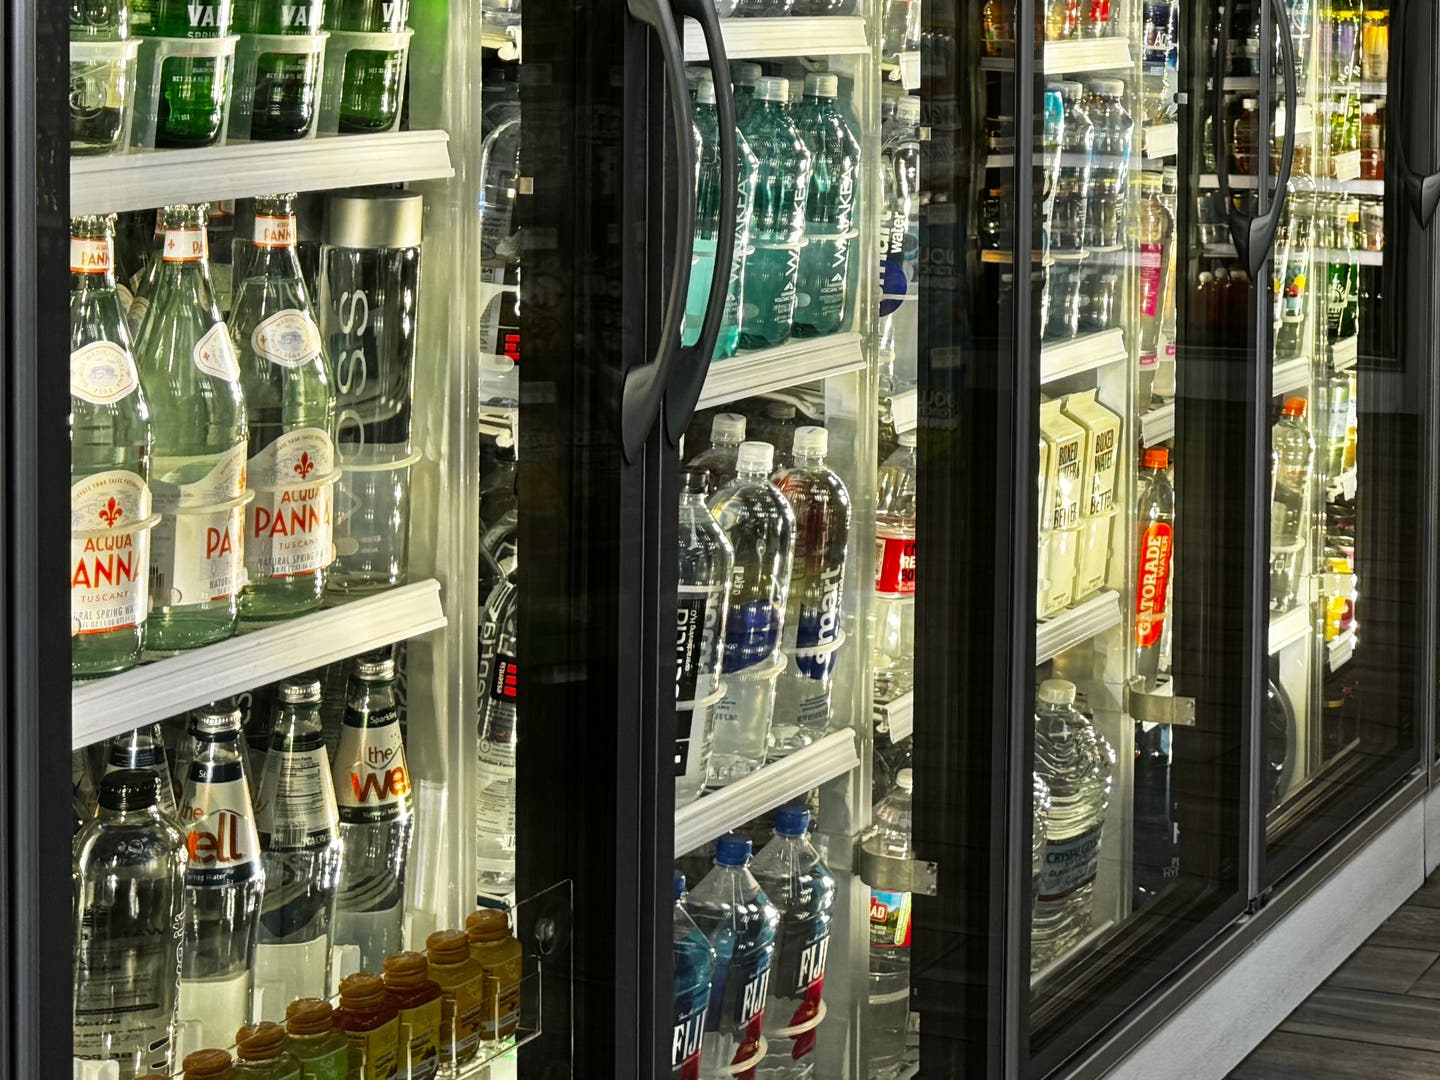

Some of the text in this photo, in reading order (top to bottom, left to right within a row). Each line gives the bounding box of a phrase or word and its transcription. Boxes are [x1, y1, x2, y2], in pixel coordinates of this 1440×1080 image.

[890, 211, 905, 254] water
[1058, 440, 1079, 465] BOXED
[1095, 427, 1114, 453] BOXED
[84, 532, 133, 553] ACQUA
[81, 589, 129, 604] TUSCANY
[1138, 534, 1169, 637] GATORADE WATER
[96, 606, 123, 619] SPRING
[496, 661, 507, 695] essentia
[368, 746, 393, 763] the
[799, 934, 830, 988] FIJI
[742, 968, 771, 1025] FIJI
[672, 1009, 707, 1068] FIJI
